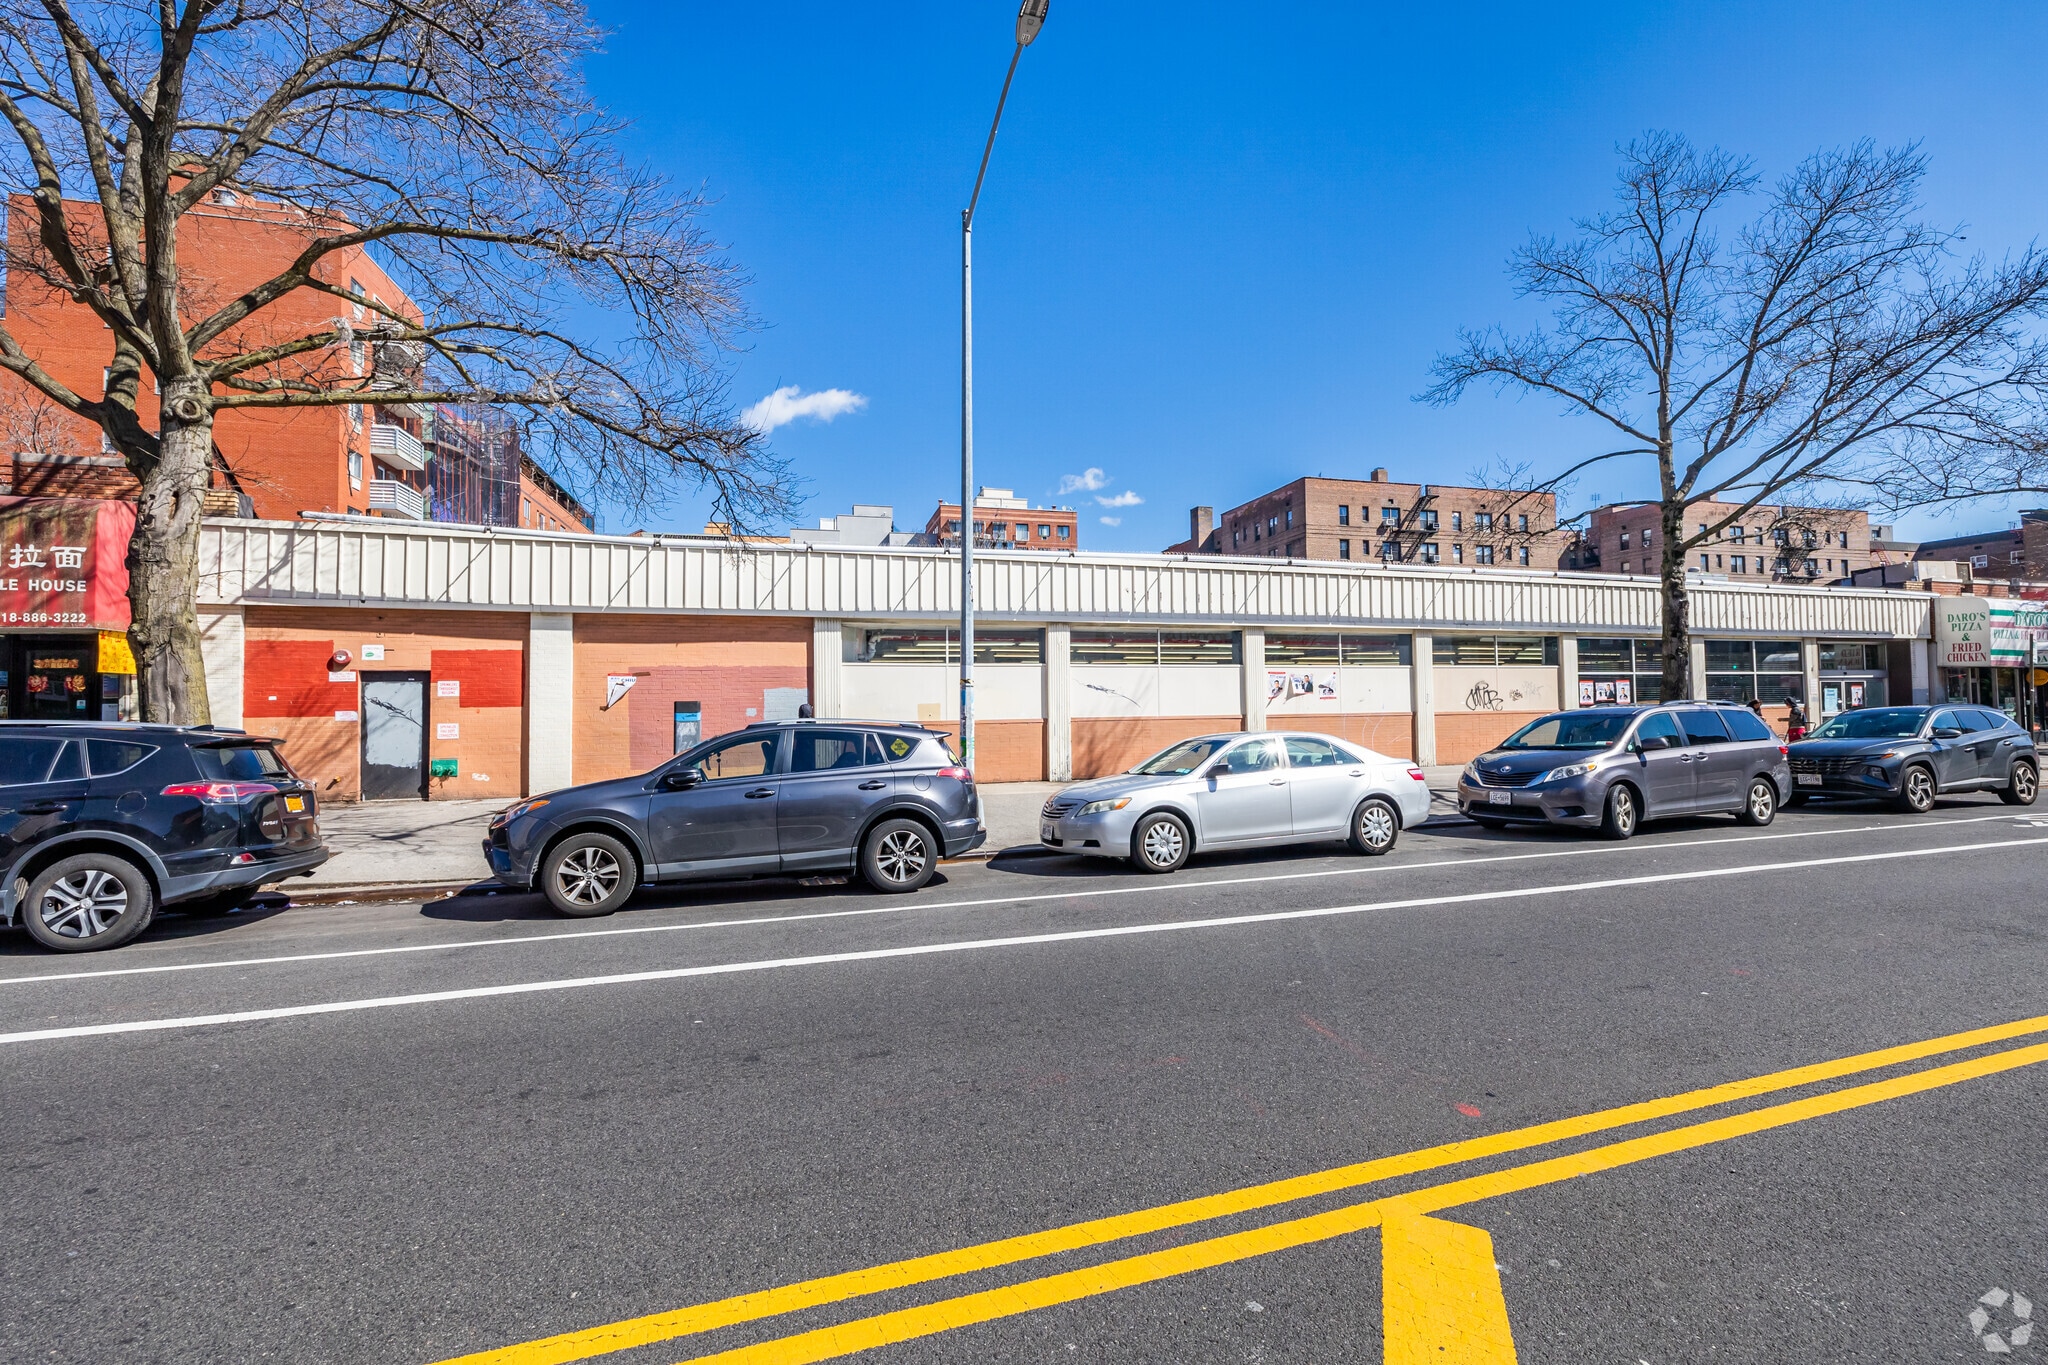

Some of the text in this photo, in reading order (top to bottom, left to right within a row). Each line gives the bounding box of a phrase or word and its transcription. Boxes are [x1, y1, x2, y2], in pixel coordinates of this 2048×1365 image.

[0, 543, 87, 568] 拉面
[28, 580, 87, 592] HOUSE
[2, 612, 87, 623] 18-886-3222
[1947, 612, 1986, 623] DARO'S
[1951, 622, 1982, 632] PIZZA
[1962, 633, 1970, 641] &
[1952, 642, 1982, 653] FRIED
[1947, 652, 1987, 663] CHICKEN
